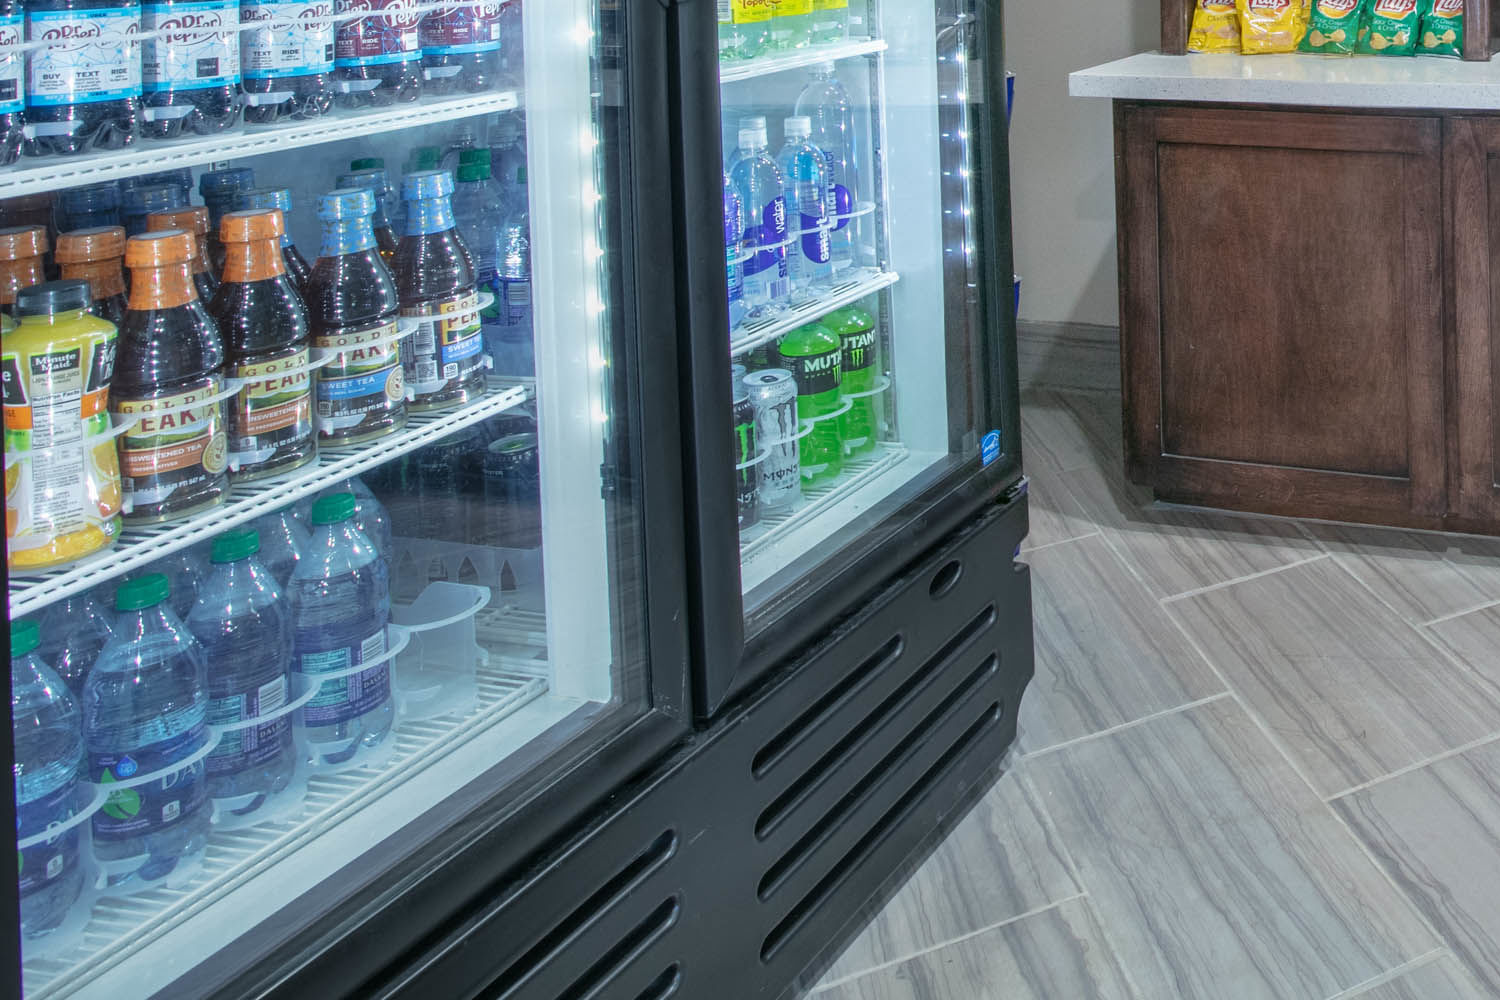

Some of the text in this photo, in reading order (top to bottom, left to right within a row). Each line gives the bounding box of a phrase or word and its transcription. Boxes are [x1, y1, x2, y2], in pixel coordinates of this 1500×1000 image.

[76, 70, 100, 78] TEXT
[35, 353, 76, 366] Minute
[41, 361, 70, 372] Maid
[356, 377, 376, 386] TEA
[123, 395, 196, 414] GOLD
[136, 409, 197, 434] EAK
[186, 443, 202, 452] TEA
